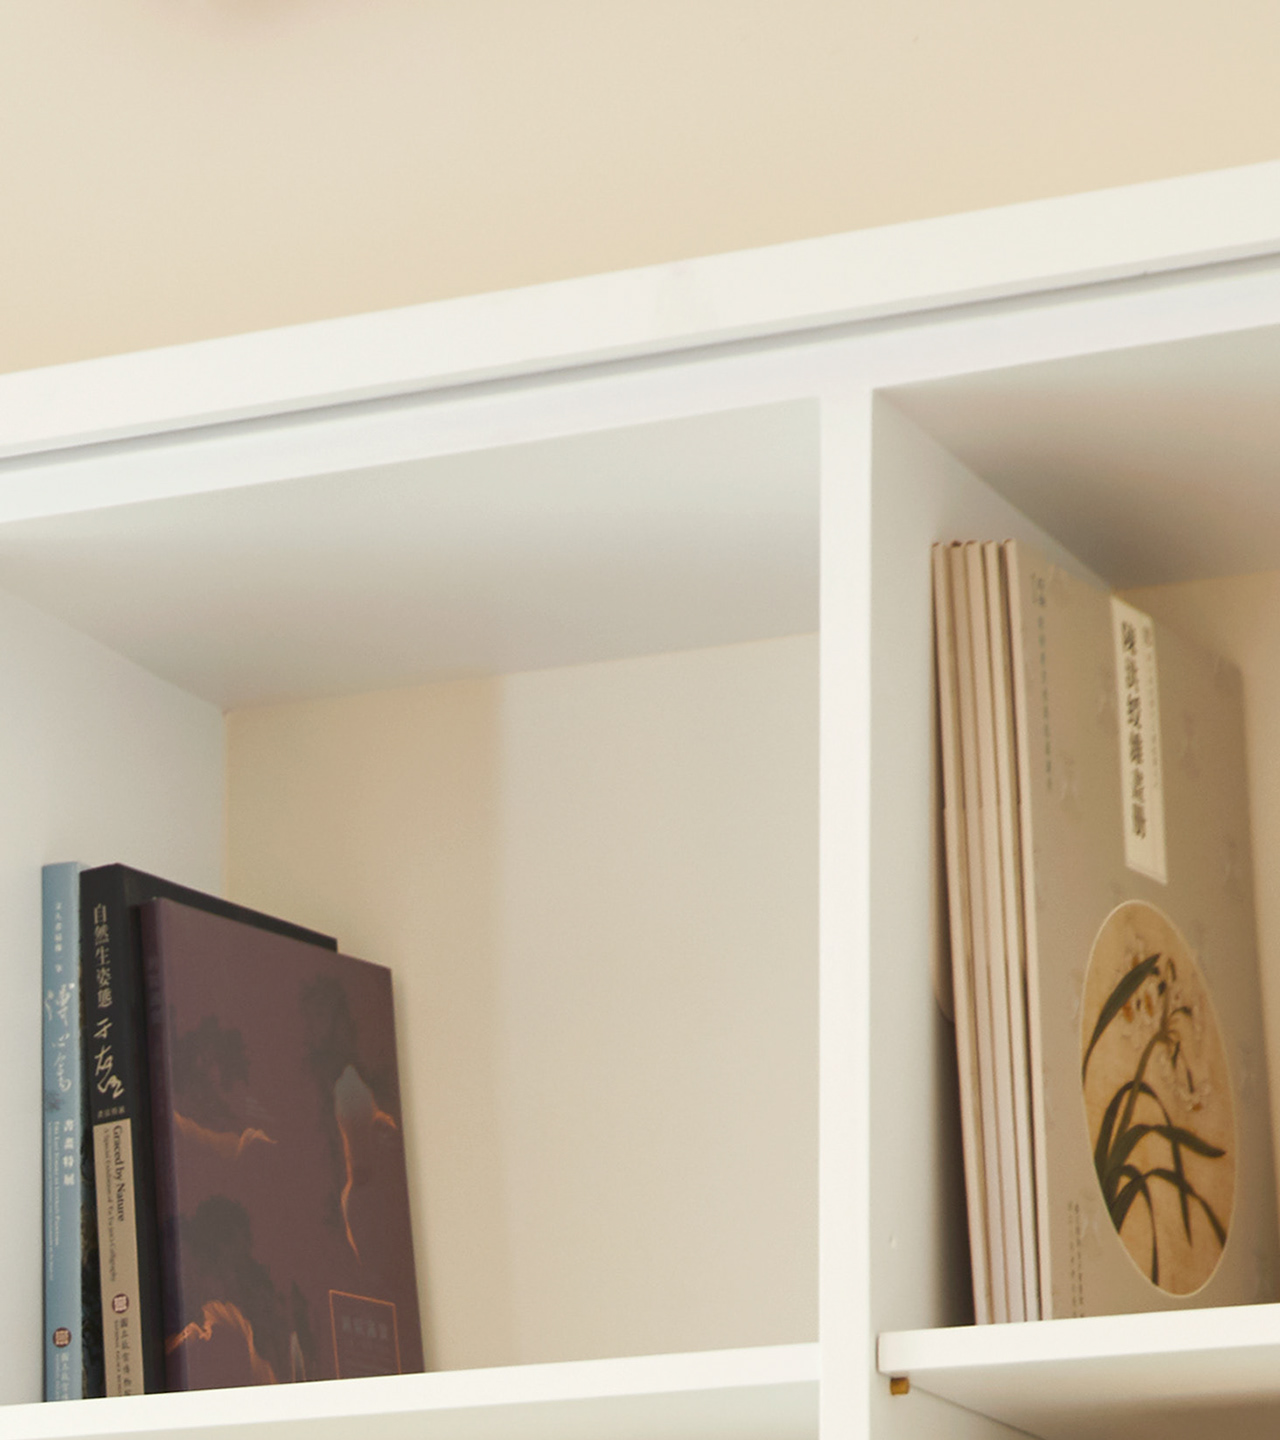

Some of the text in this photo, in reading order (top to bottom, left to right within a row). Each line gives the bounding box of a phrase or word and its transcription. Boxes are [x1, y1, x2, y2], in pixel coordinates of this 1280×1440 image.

[93, 904, 113, 1009] 自然生姿態
[112, 1126, 127, 1222] Graced by Nature
